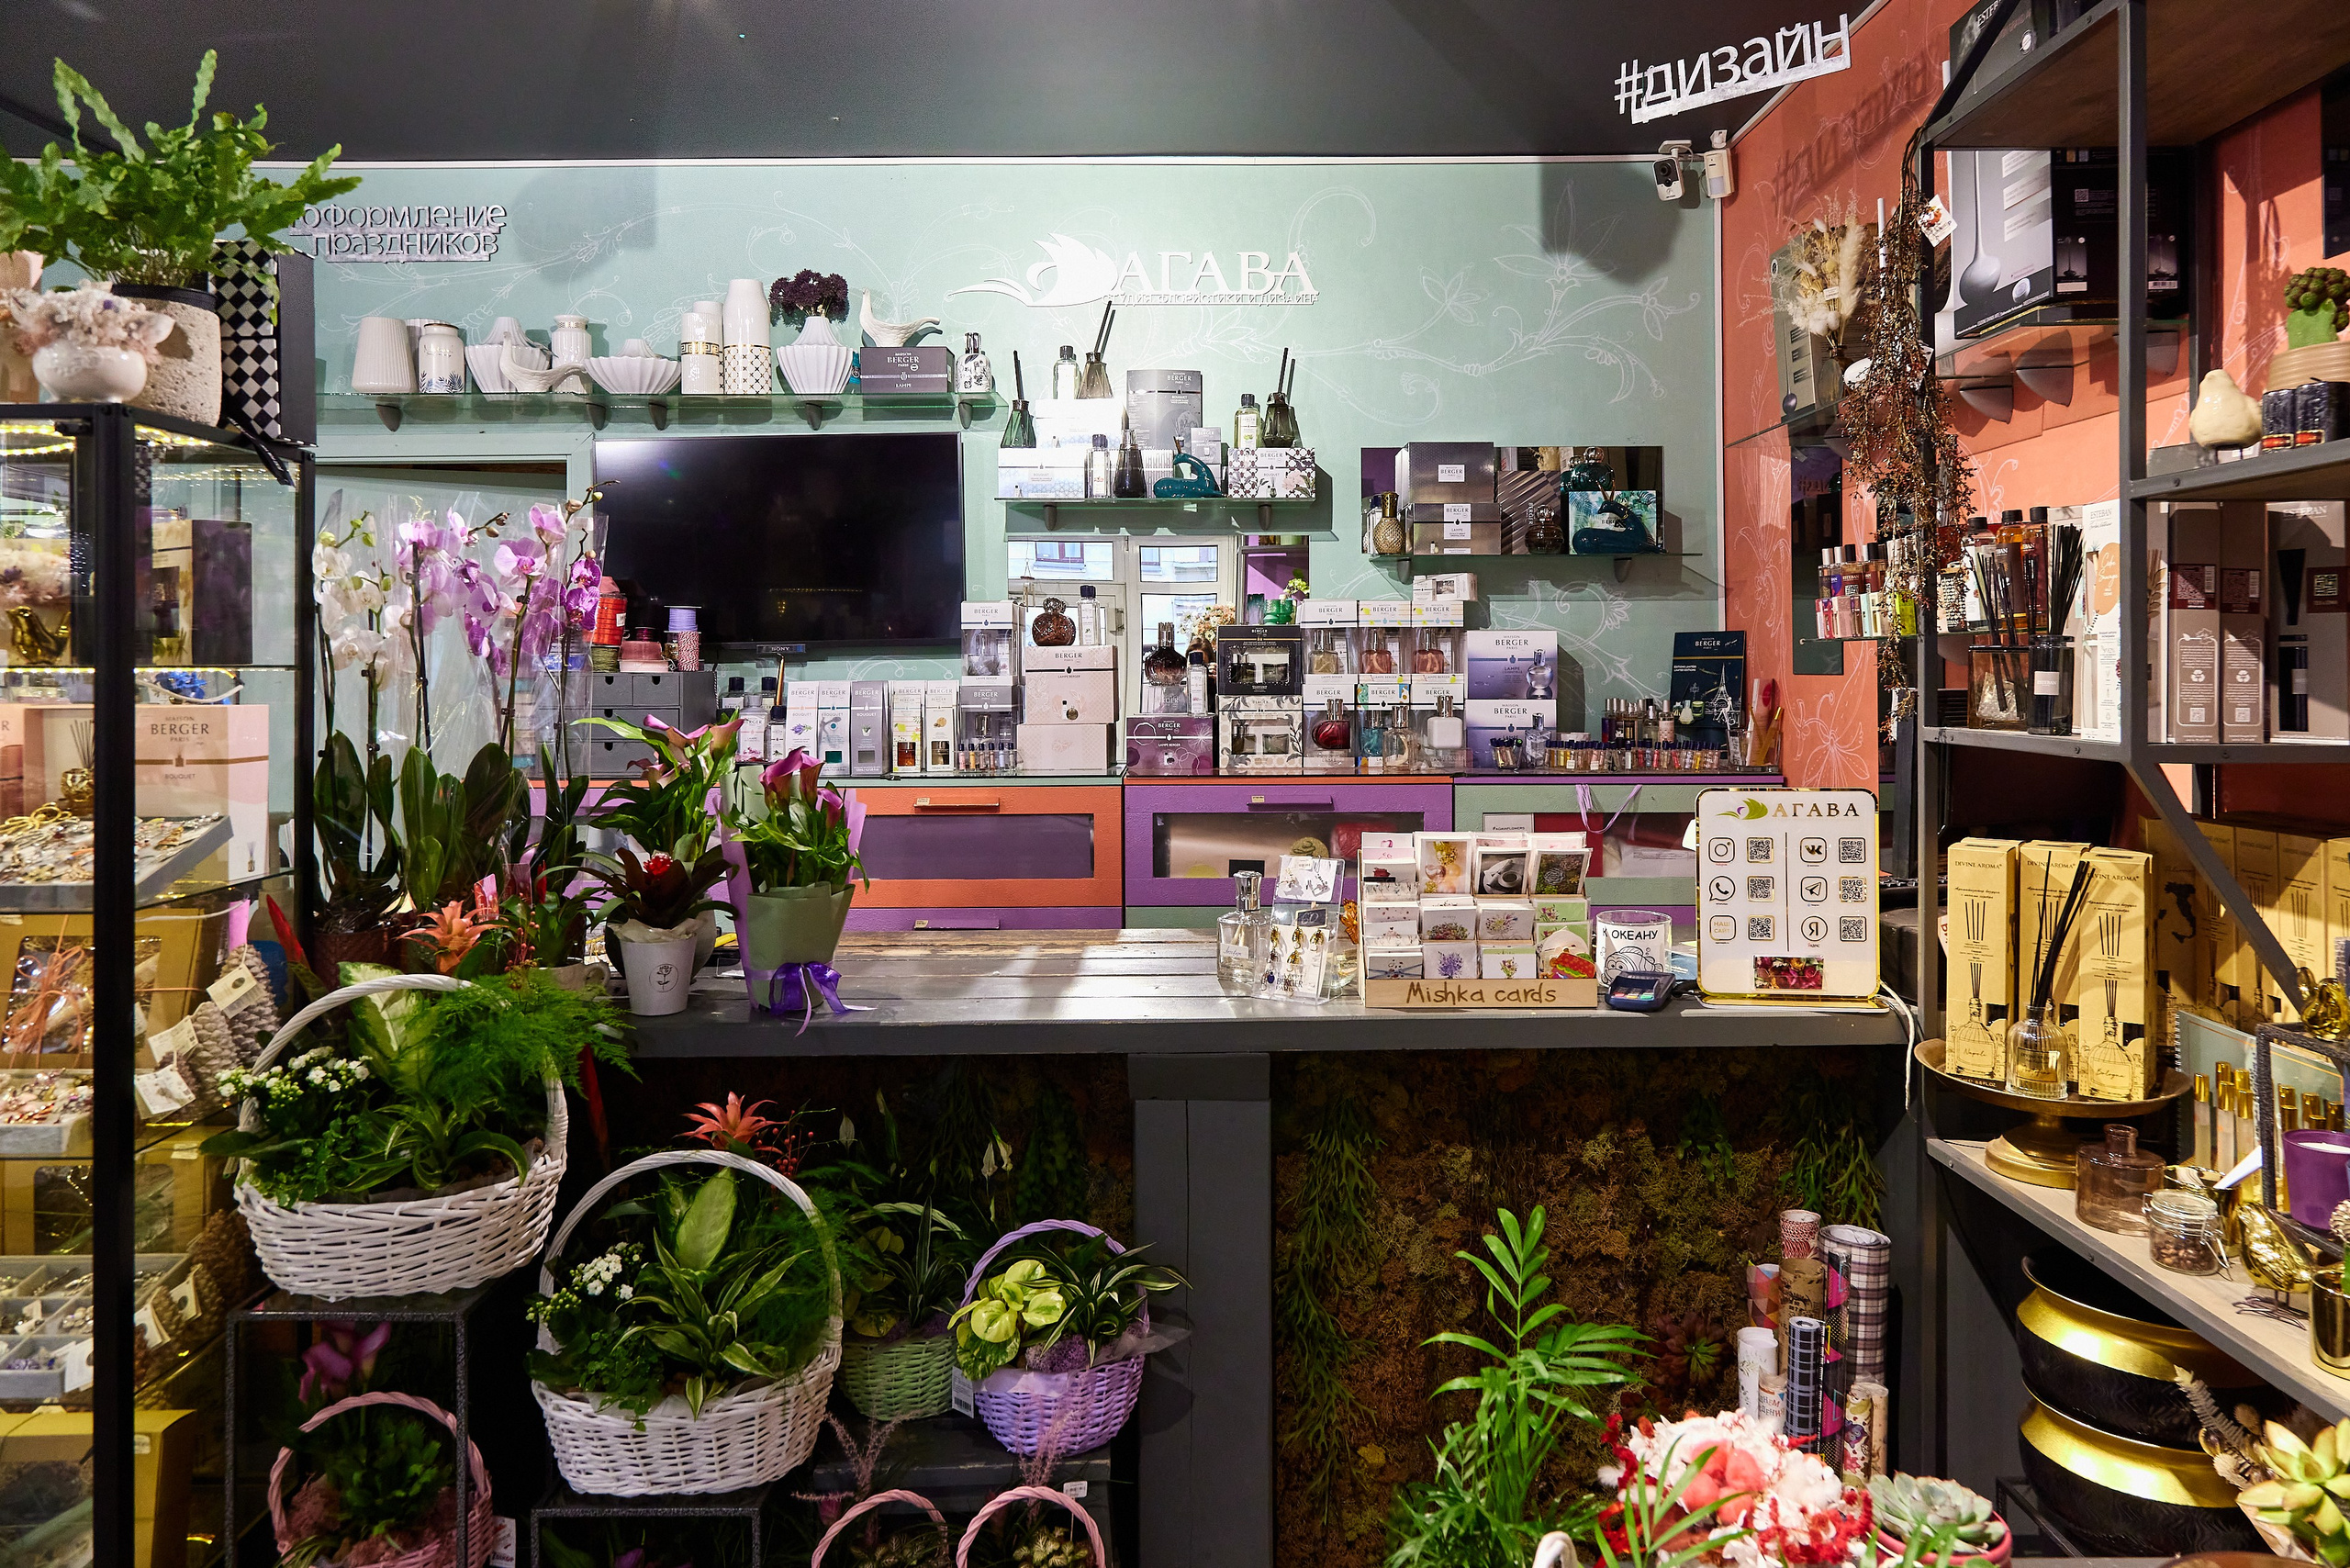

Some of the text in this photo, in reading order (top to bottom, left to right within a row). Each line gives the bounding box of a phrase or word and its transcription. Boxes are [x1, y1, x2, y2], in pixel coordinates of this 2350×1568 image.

[1614, 13, 1852, 124] #дизайн
[292, 204, 507, 229] оформление
[312, 232, 498, 263] праздников
[1112, 251, 1320, 296] АГАВА
[1158, 292, 1244, 305] ФЛОРИСТИКИ
[2090, 509, 2112, 519] ESTEBAN
[151, 722, 209, 734] BERGER
[1772, 802, 1860, 817] АГАВА
[1602, 927, 1658, 940] К ОКЕАНУ
[1808, 922, 1818, 936] Я
[1406, 980, 1557, 1005] Mishka cards
